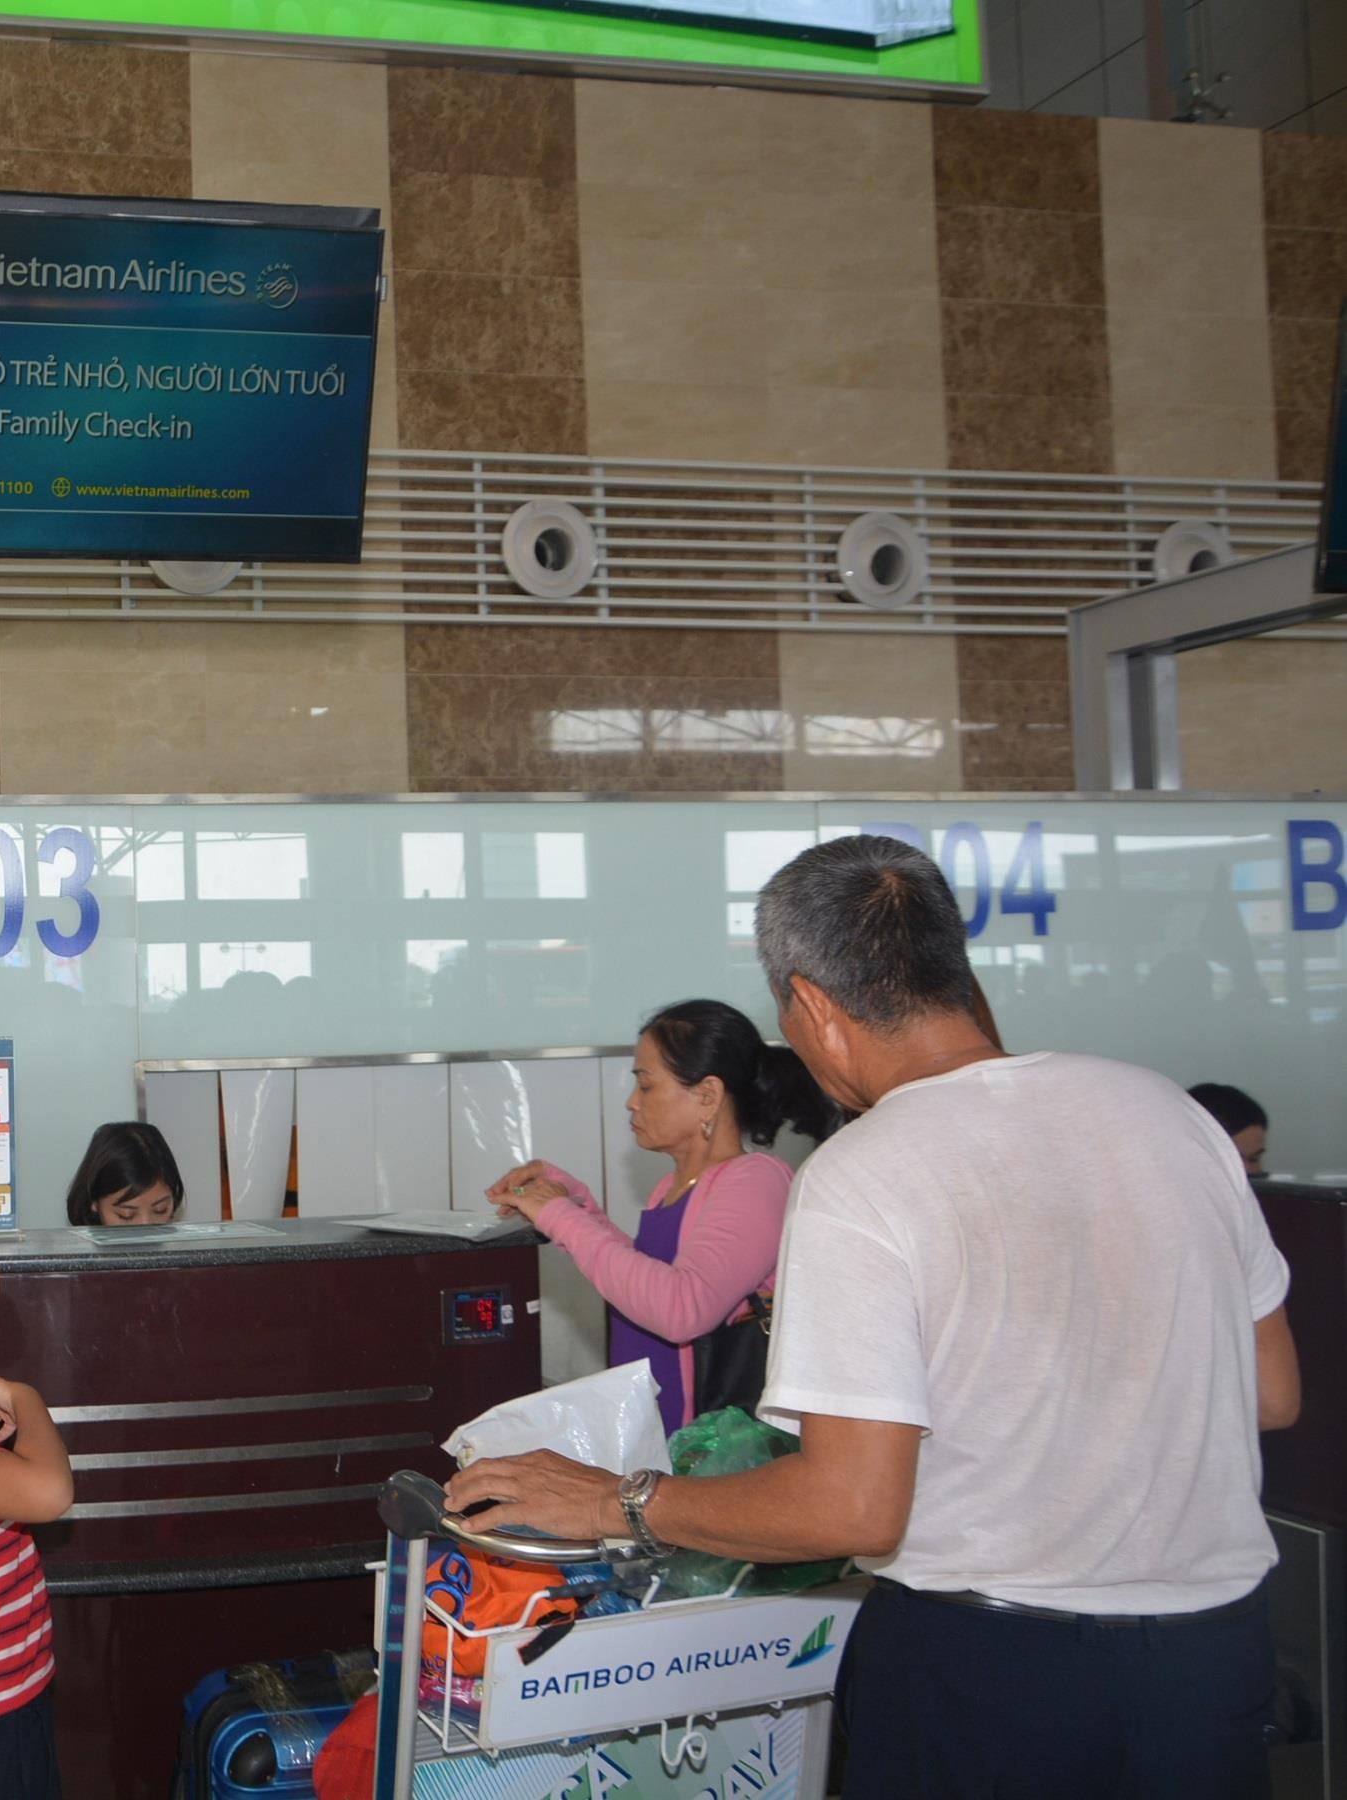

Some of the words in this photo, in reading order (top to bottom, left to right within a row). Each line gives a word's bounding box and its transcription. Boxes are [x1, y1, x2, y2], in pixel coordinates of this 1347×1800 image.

[119, 258, 246, 296] Airlines
[9, 354, 58, 387] TRẺ
[64, 355, 129, 393] NHỎ,
[136, 361, 223, 393] NGƯỜI
[229, 363, 281, 394] LỚN
[285, 363, 345, 396] TUỔI
[84, 411, 194, 440] Check-in
[76, 483, 251, 500] www.vietnamairlines.com
[520, 1660, 655, 1701] BAMBOO
[666, 1637, 792, 1678] AIRWAYS
